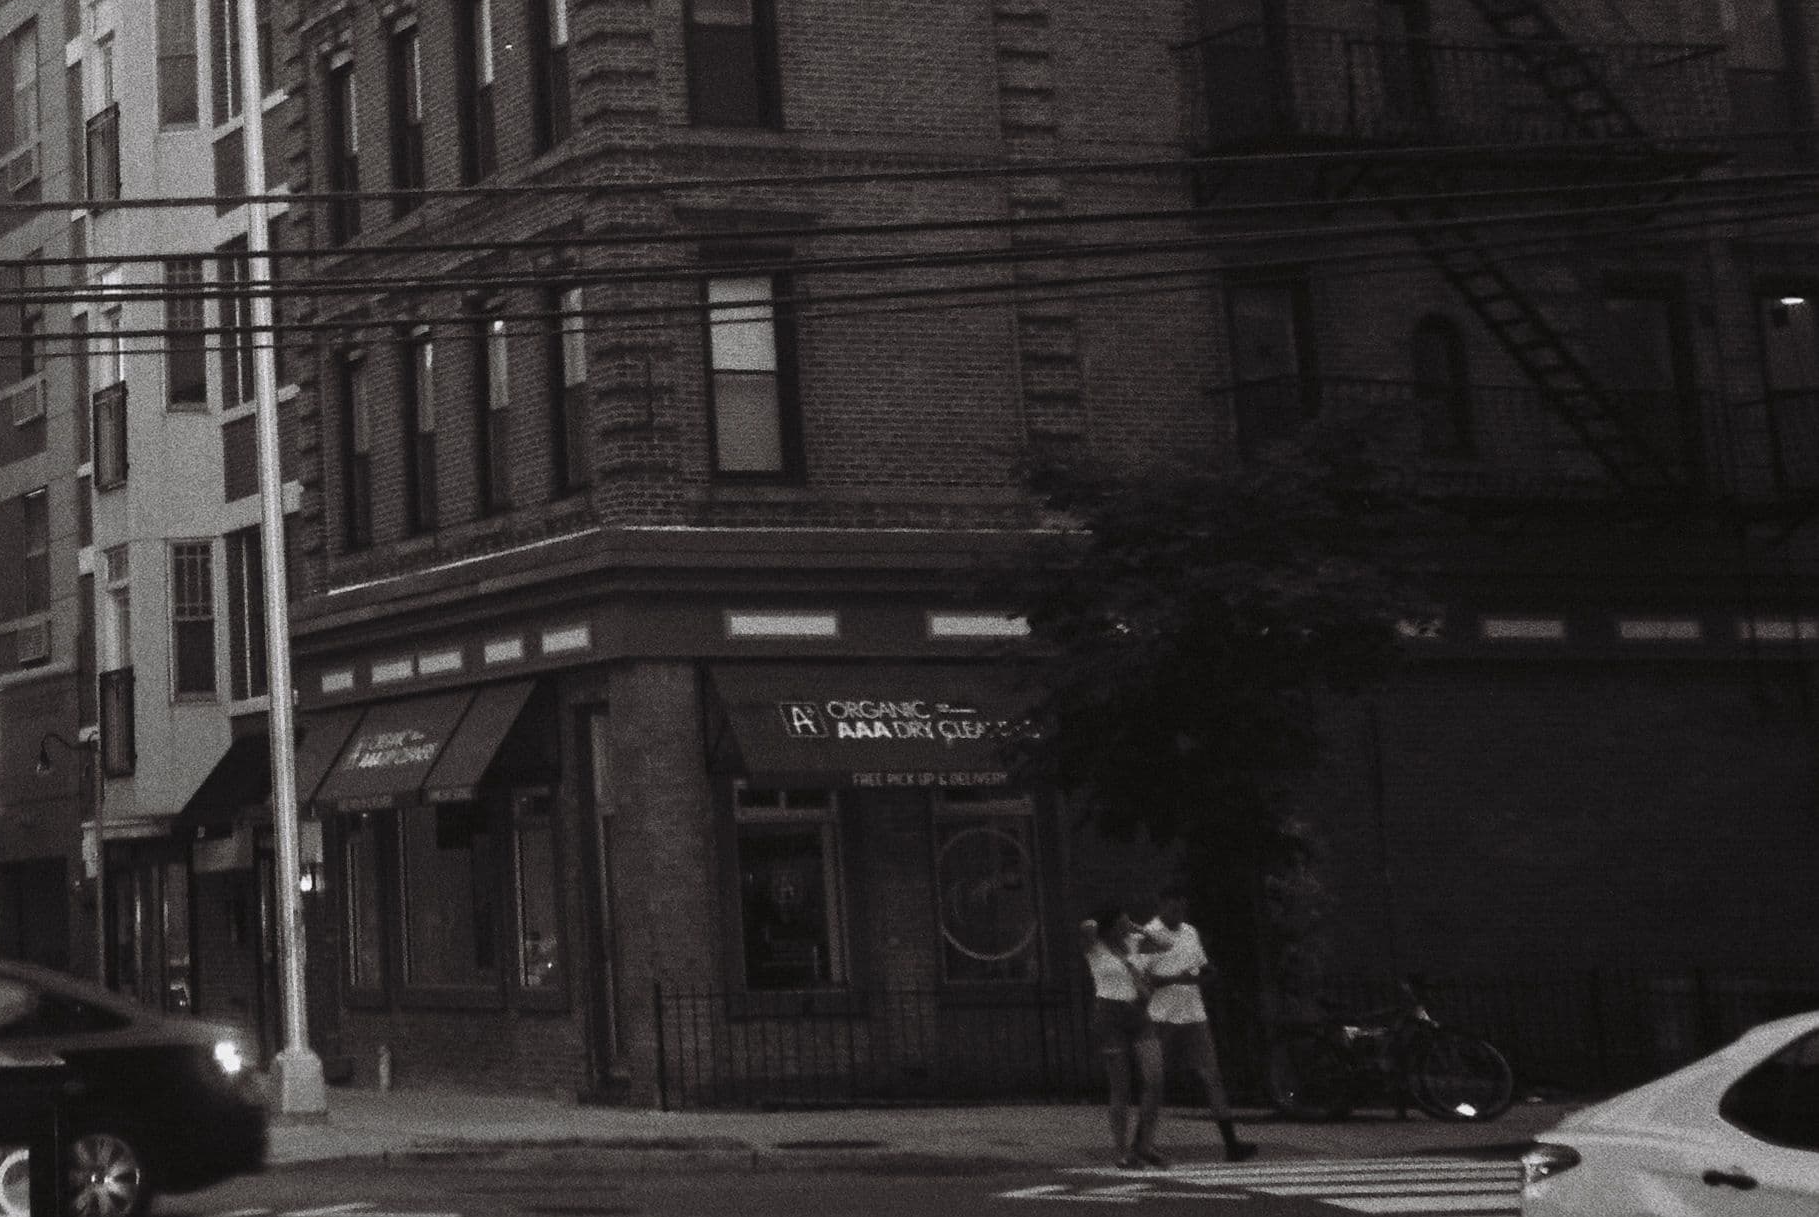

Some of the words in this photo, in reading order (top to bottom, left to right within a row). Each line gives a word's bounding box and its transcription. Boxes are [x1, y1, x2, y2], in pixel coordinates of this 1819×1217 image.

[826, 700, 931, 720] ORGANIC
[837, 720, 892, 739] AAA
[892, 721, 935, 740] DRY
[852, 771, 883, 787] FREE
[917, 771, 936, 786] UP
[949, 770, 1008, 786] DELIVERY
